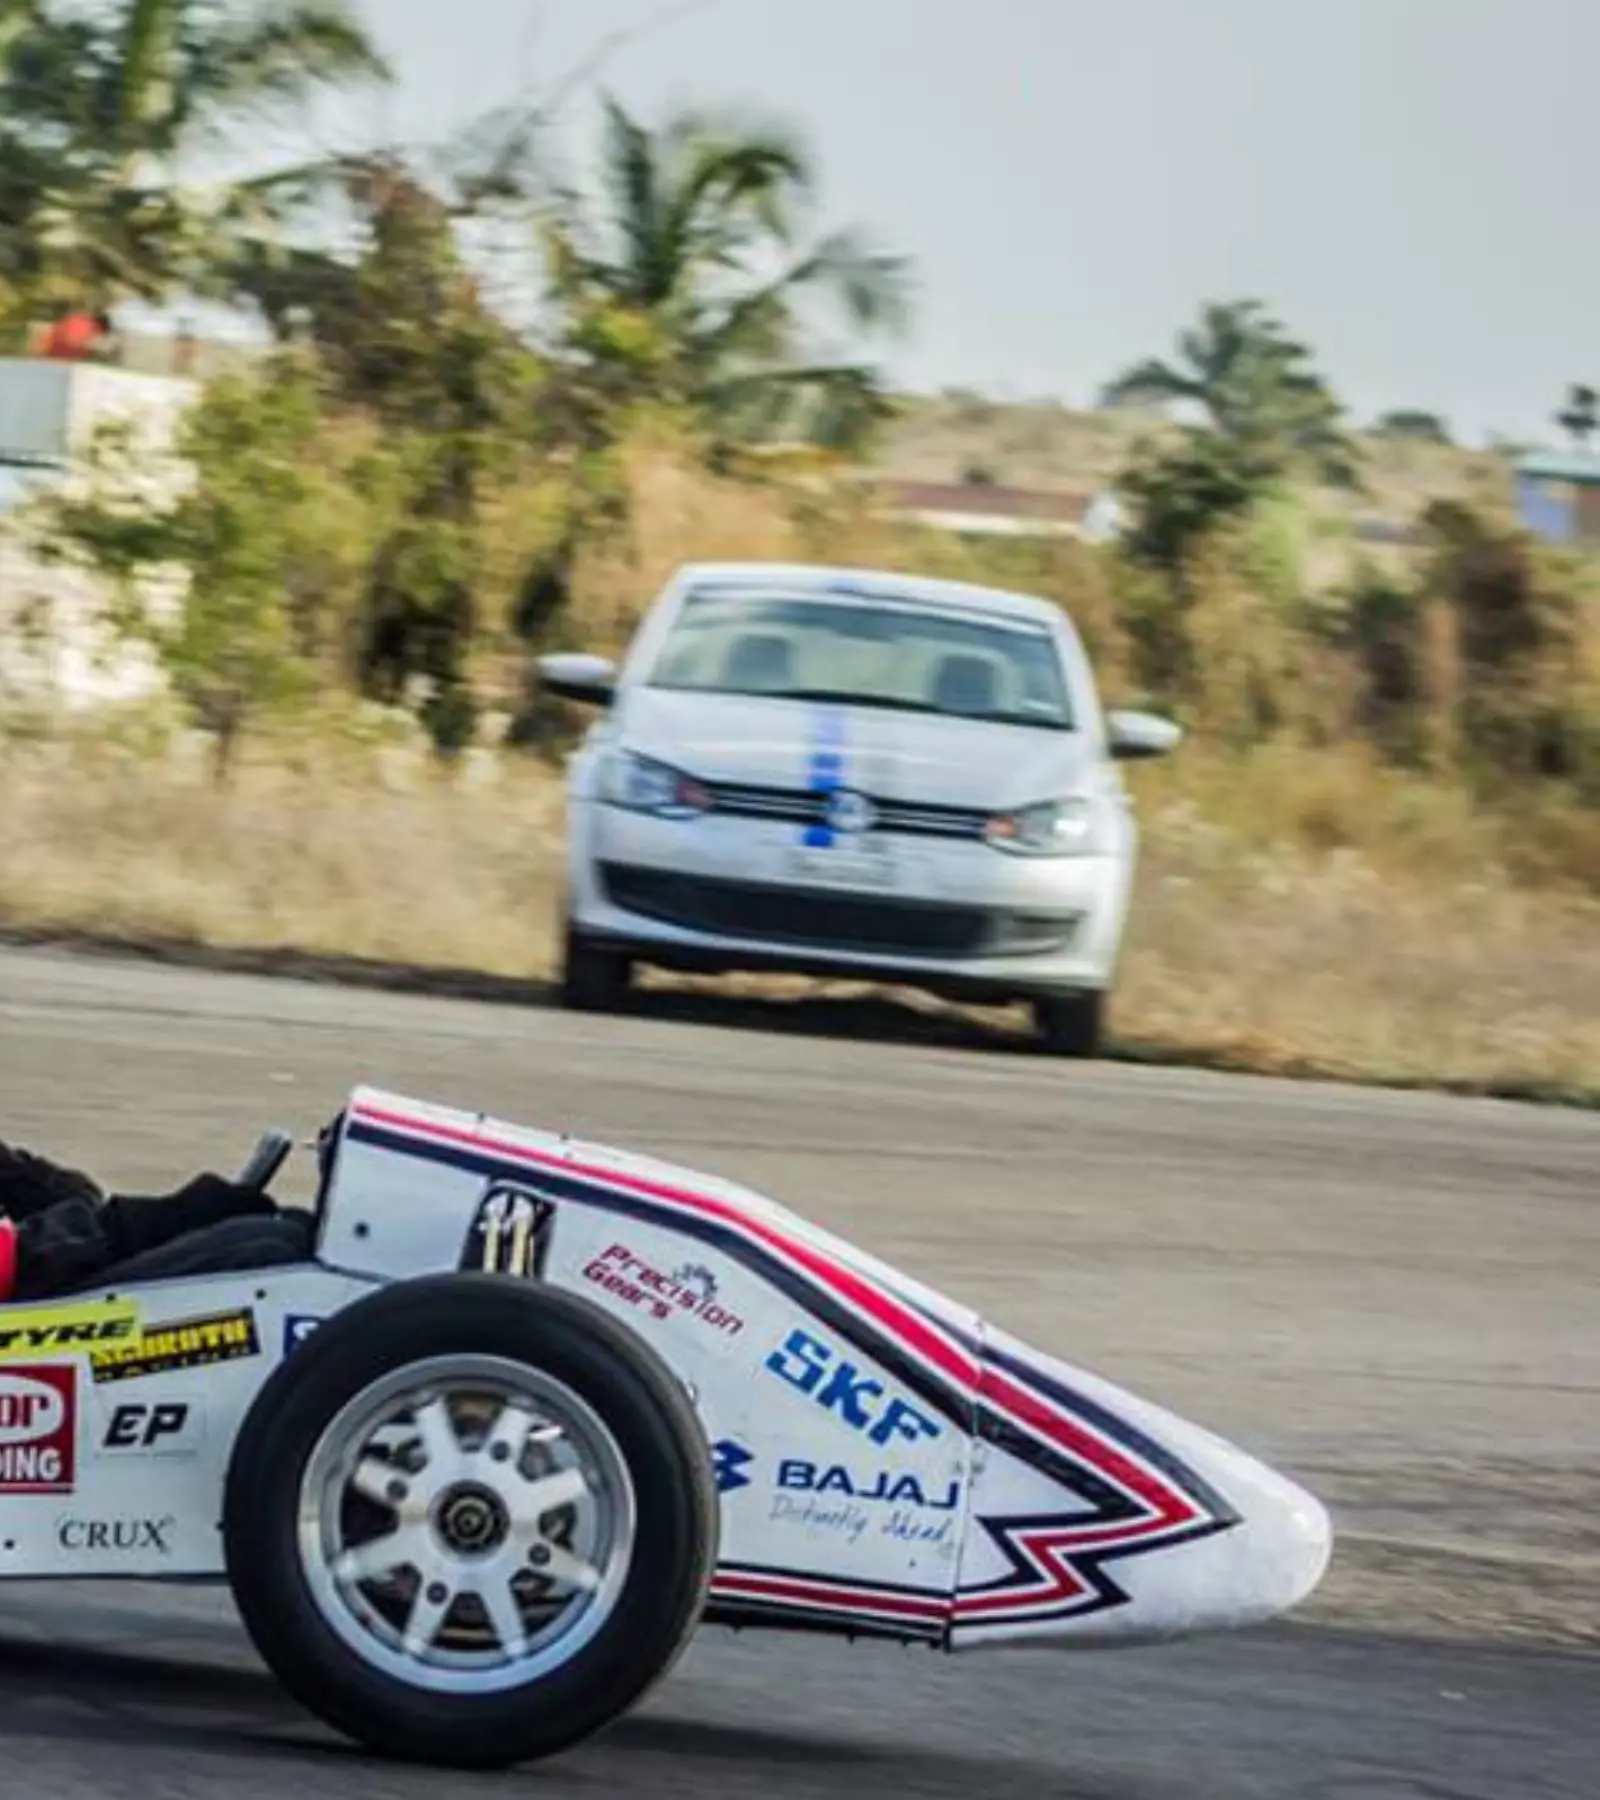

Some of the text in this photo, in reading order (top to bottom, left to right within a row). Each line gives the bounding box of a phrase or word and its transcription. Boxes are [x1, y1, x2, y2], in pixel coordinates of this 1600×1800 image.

[583, 1260, 673, 1320] Gears
[763, 1328, 940, 1445] SKF
[103, 1403, 188, 1446] EP
[777, 1460, 960, 1509] BAJAJ
[59, 1518, 175, 1553] CRUX
